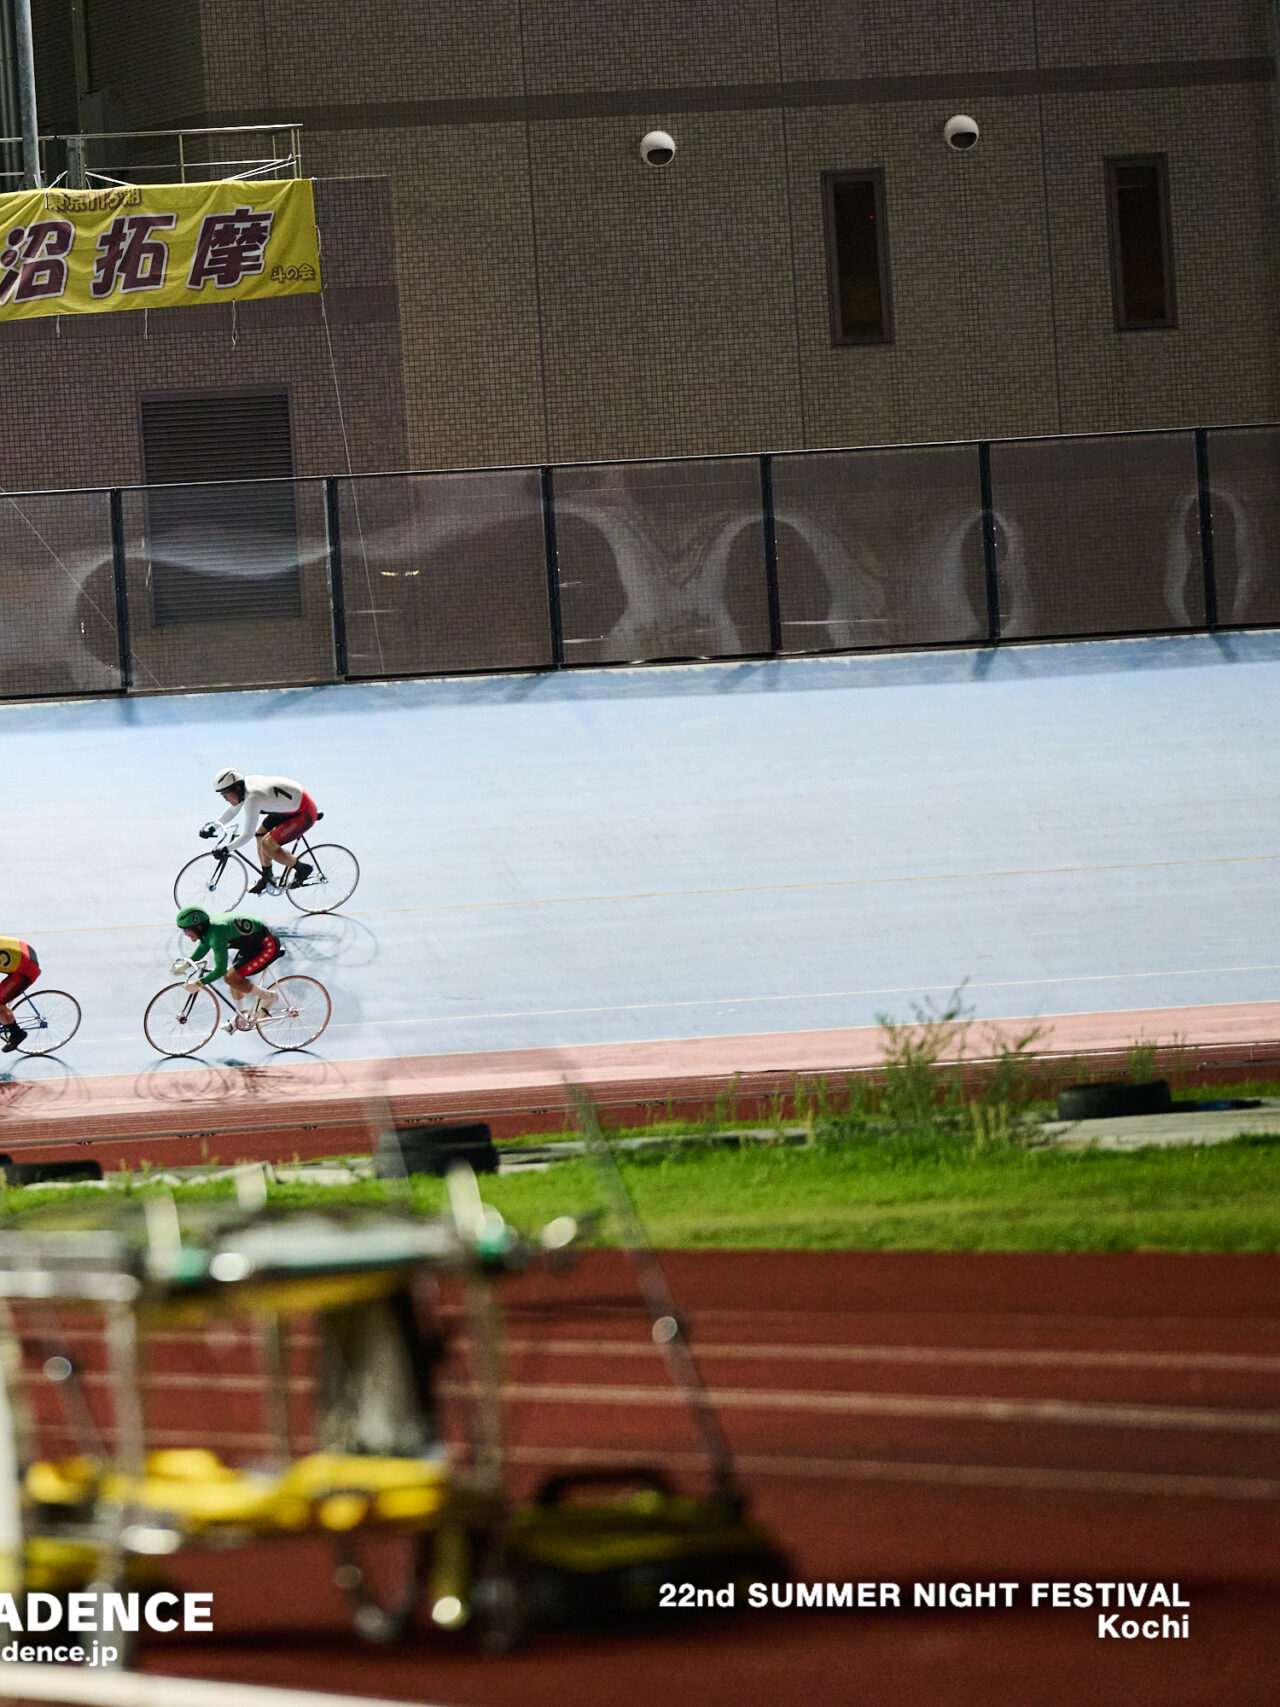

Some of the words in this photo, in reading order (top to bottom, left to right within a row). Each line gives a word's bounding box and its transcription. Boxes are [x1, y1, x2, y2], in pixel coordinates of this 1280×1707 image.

[270, 263, 316, 284] 斗の会
[272, 785, 293, 801] 1
[232, 916, 255, 936] 6
